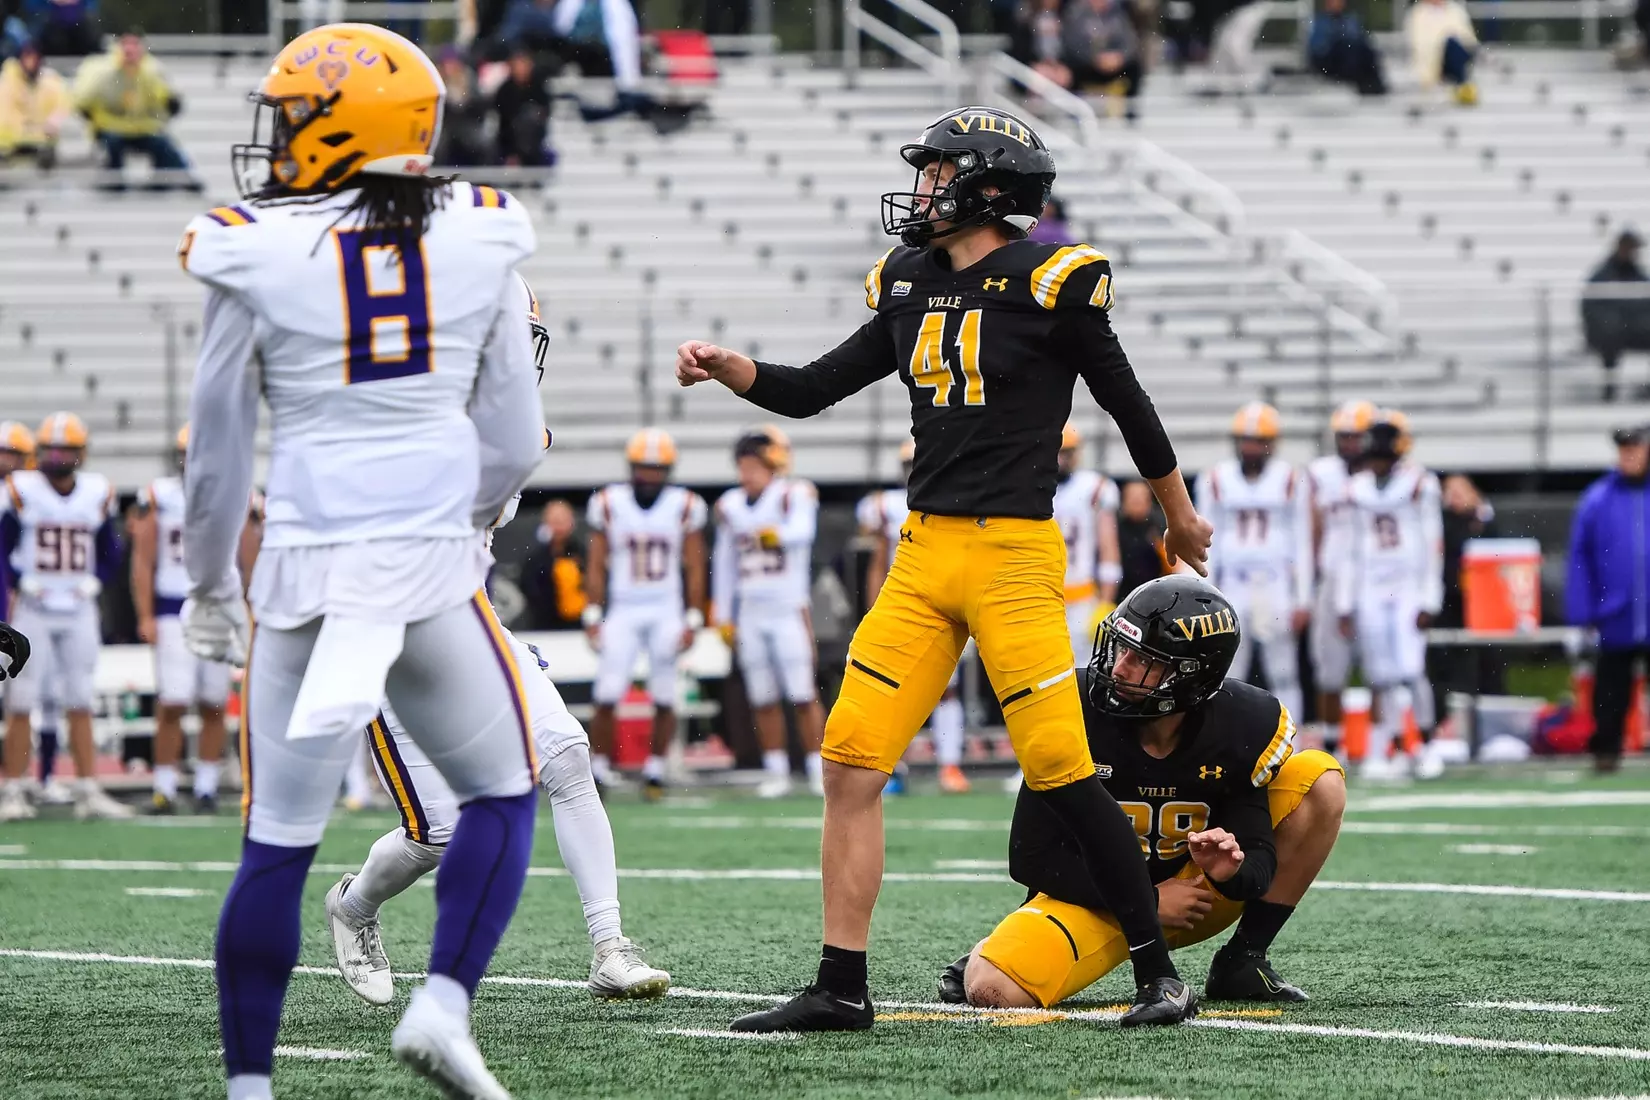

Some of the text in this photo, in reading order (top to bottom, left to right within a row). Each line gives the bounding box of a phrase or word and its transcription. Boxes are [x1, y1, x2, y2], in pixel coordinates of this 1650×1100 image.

[295, 42, 378, 66] WCU
[952, 114, 1032, 148] VILLE
[328, 228, 435, 386] 8
[928, 296, 962, 310] VILLE
[910, 309, 986, 407] 41
[37, 524, 87, 573] 96
[1173, 608, 1236, 642] VILLE
[1138, 787, 1177, 798] VILLE
